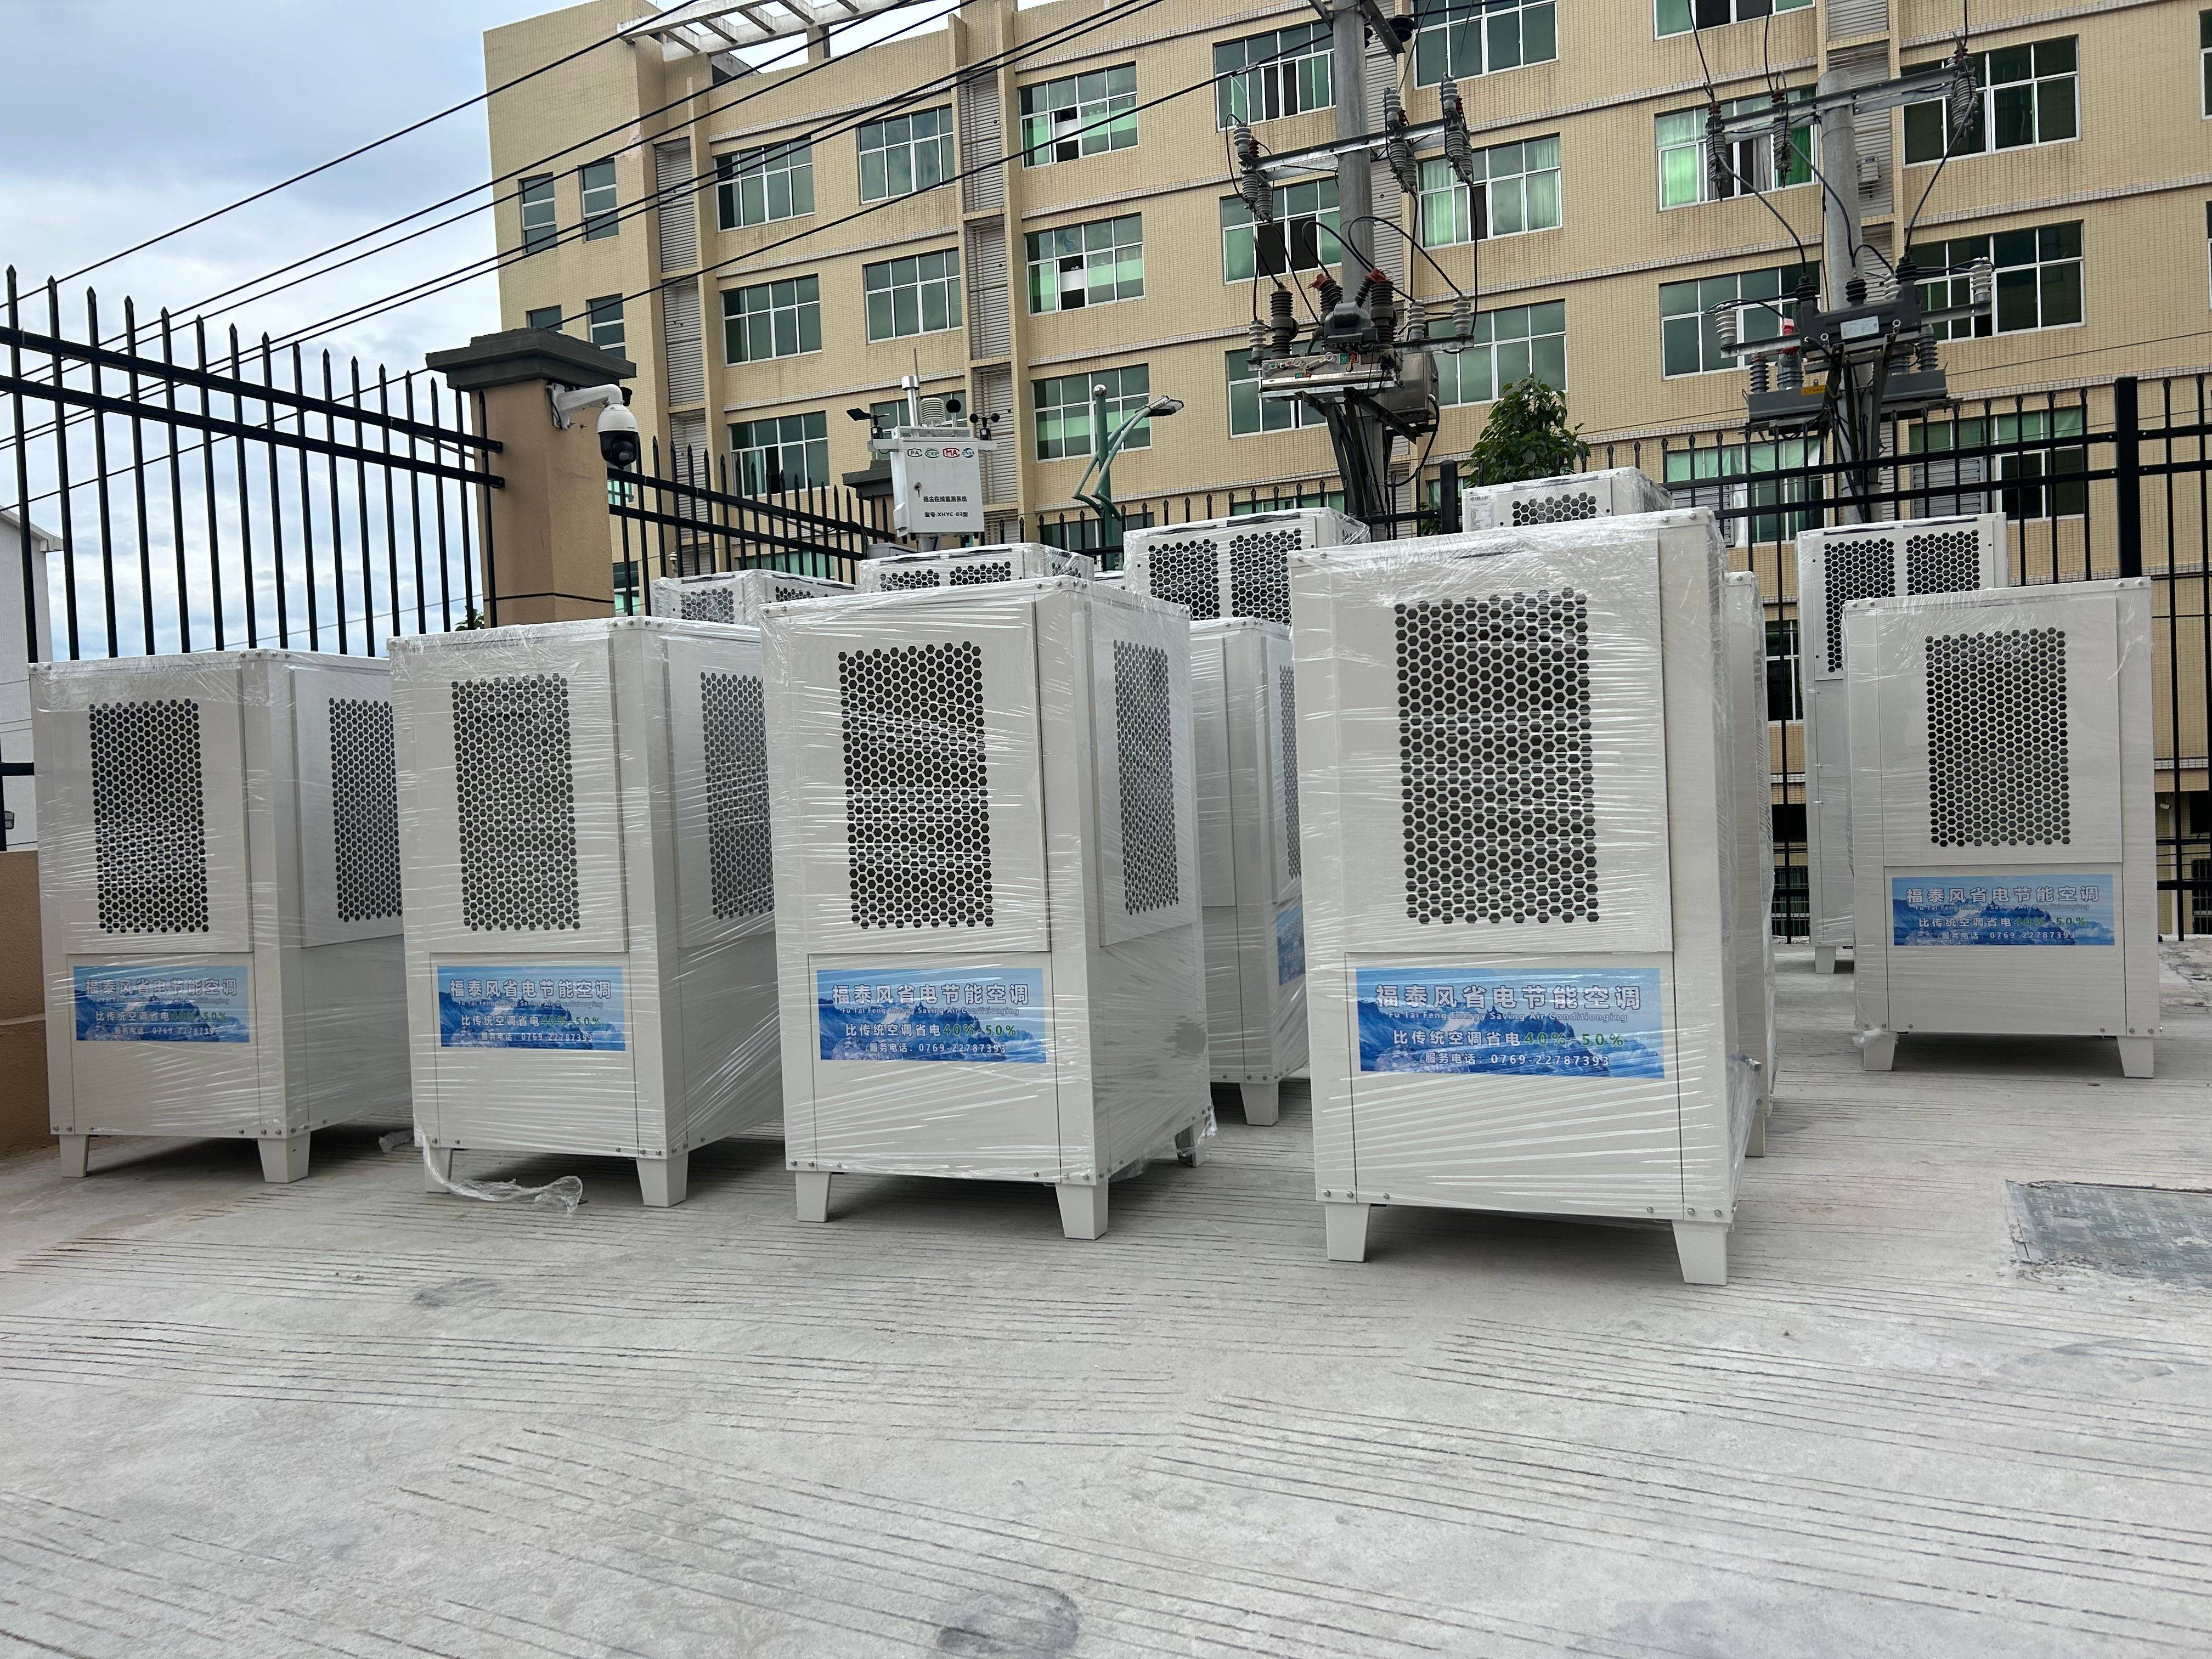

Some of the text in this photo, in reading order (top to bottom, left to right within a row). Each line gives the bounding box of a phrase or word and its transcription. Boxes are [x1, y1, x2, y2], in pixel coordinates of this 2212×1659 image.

[1906, 886, 2100, 904] 福泰风省电节能空调
[1919, 917, 2086, 928] 比传统空调省电40%50%
[86, 978, 238, 996] 福泰风省电节能空调
[450, 979, 612, 998] 福泰风省电节能空调
[832, 984, 1029, 1005] 福泰风省电节能空调
[1375, 984, 1641, 1010] 福泰风省电节能空调
[918, 1007, 944, 1016] Saving
[1403, 1011, 1419, 1019] Tai
[1423, 1012, 1447, 1021] Feng
[1451, 1012, 1486, 1022] Energy
[1490, 1012, 1525, 1022] Saving
[1529, 1012, 1544, 1020] Air
[1393, 1030, 1624, 1047] 比传统空调省电40%-50%
